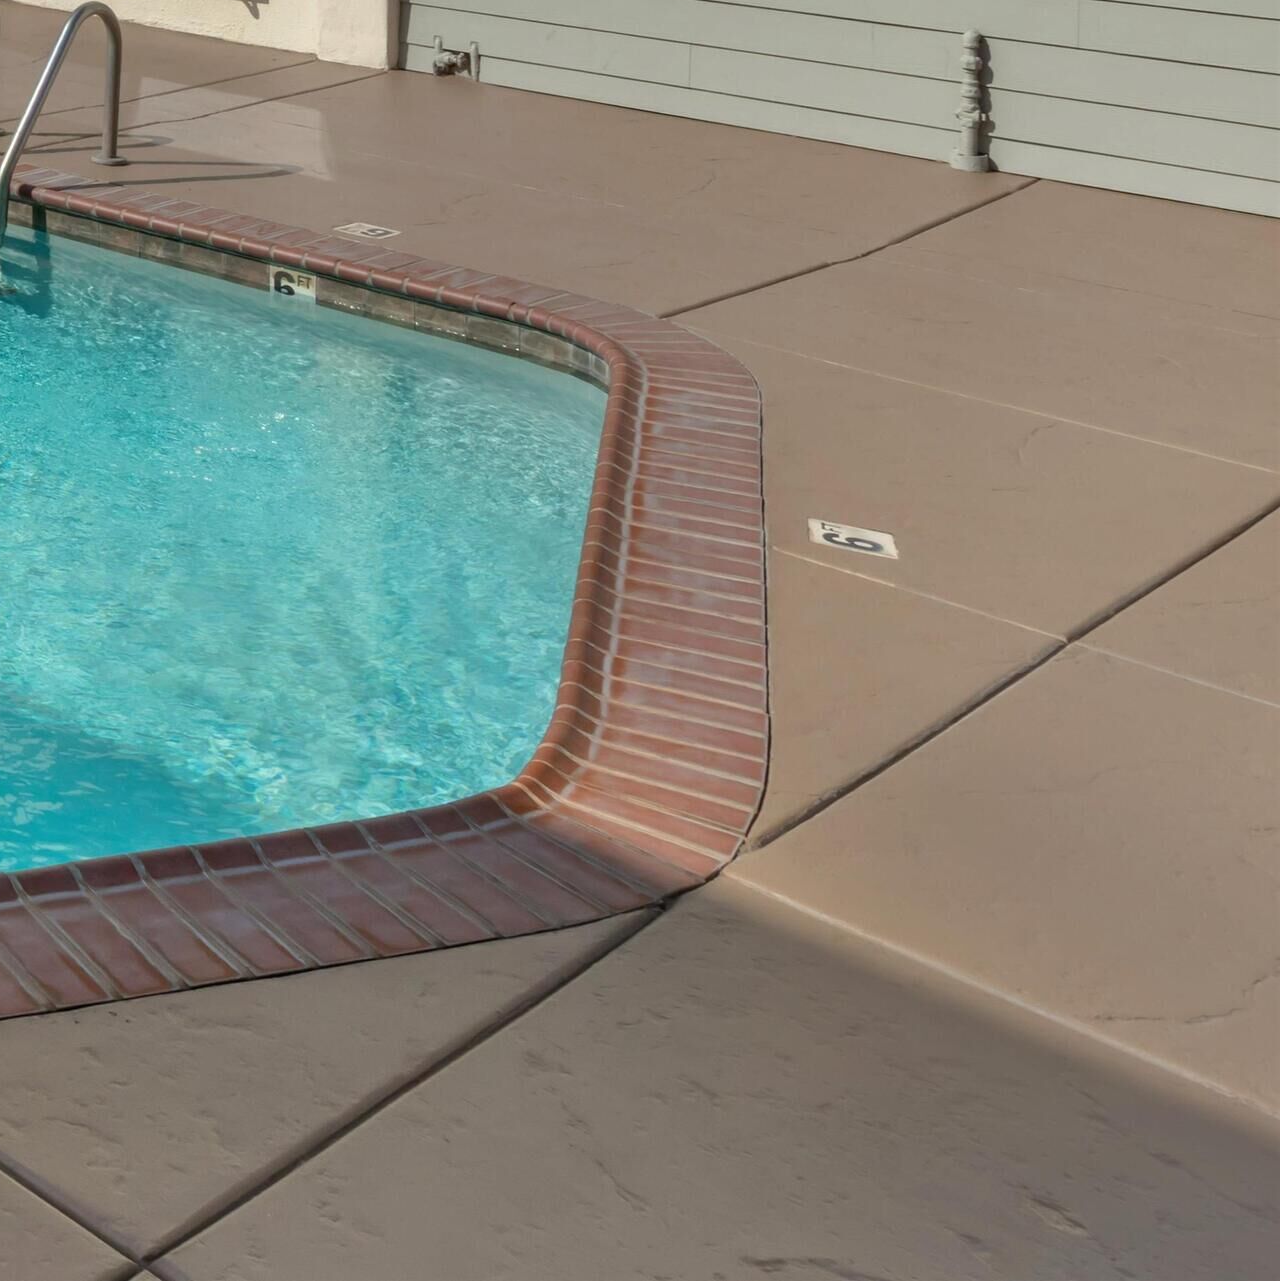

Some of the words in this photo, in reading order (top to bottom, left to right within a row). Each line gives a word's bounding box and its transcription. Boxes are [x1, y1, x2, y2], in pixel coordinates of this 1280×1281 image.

[273, 270, 295, 296] 6
[297, 275, 312, 290] FT
[822, 532, 884, 552] 6
